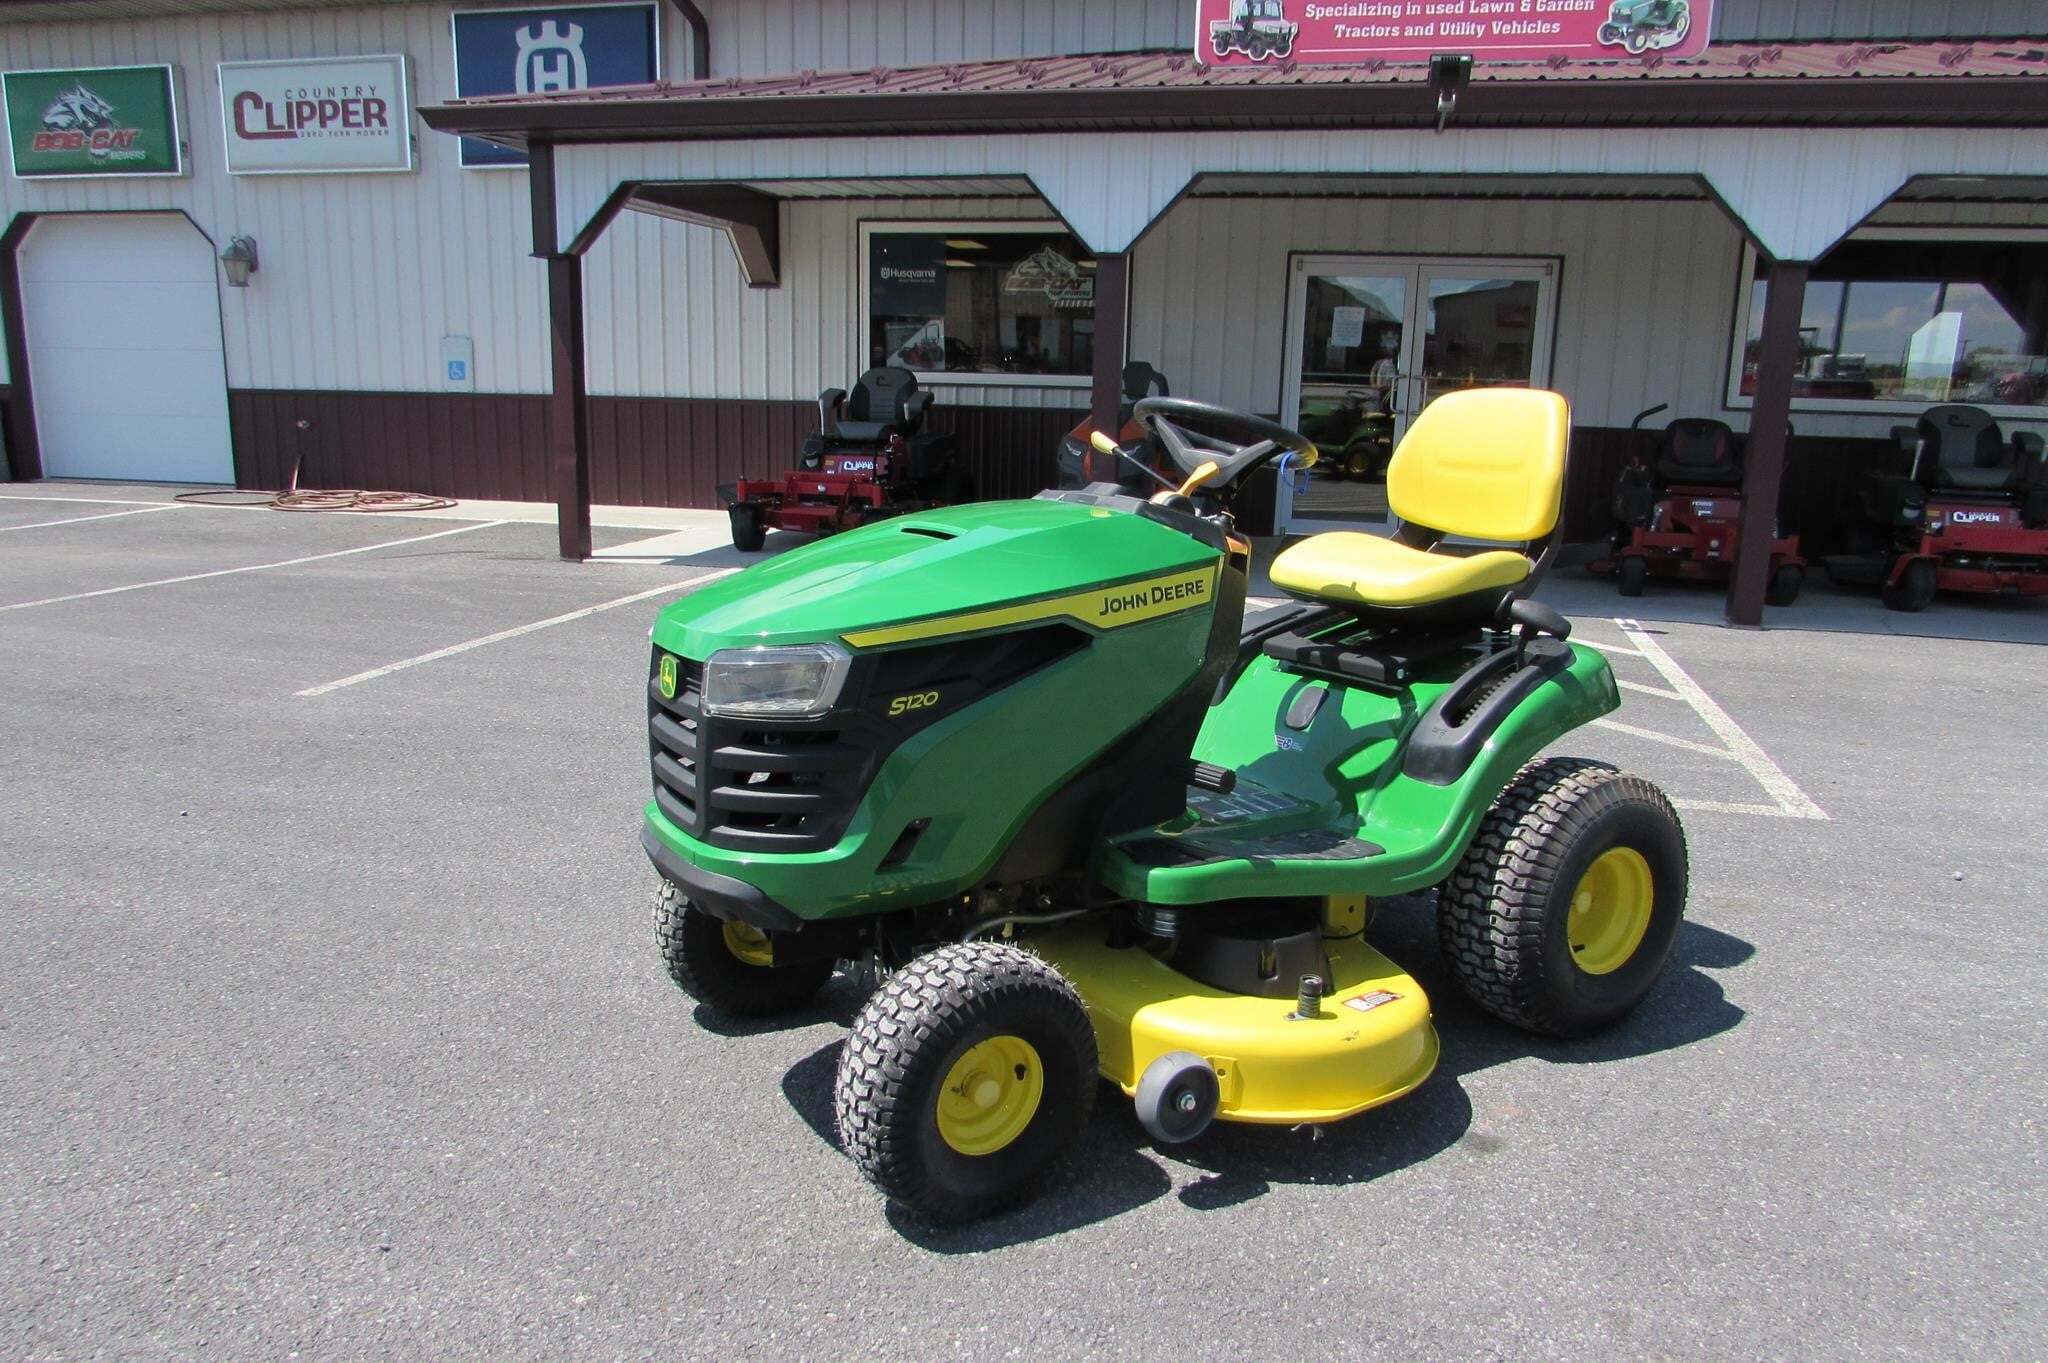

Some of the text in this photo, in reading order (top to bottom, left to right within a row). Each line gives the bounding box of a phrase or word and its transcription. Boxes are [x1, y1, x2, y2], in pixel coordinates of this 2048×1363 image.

[1305, 0, 1595, 20] Specializing in used Lawn & Garden
[1334, 19, 1561, 38] Tractors and Utility Vehicles
[284, 85, 377, 100] COUNTRY
[233, 90, 389, 140] CLIPPER
[33, 128, 143, 152] BOB-CAT
[890, 267, 936, 279] Husqvarna
[1952, 511, 2000, 522] CLIPPER
[1099, 579, 1205, 616] JOHN DEERE
[888, 691, 939, 716] S120
